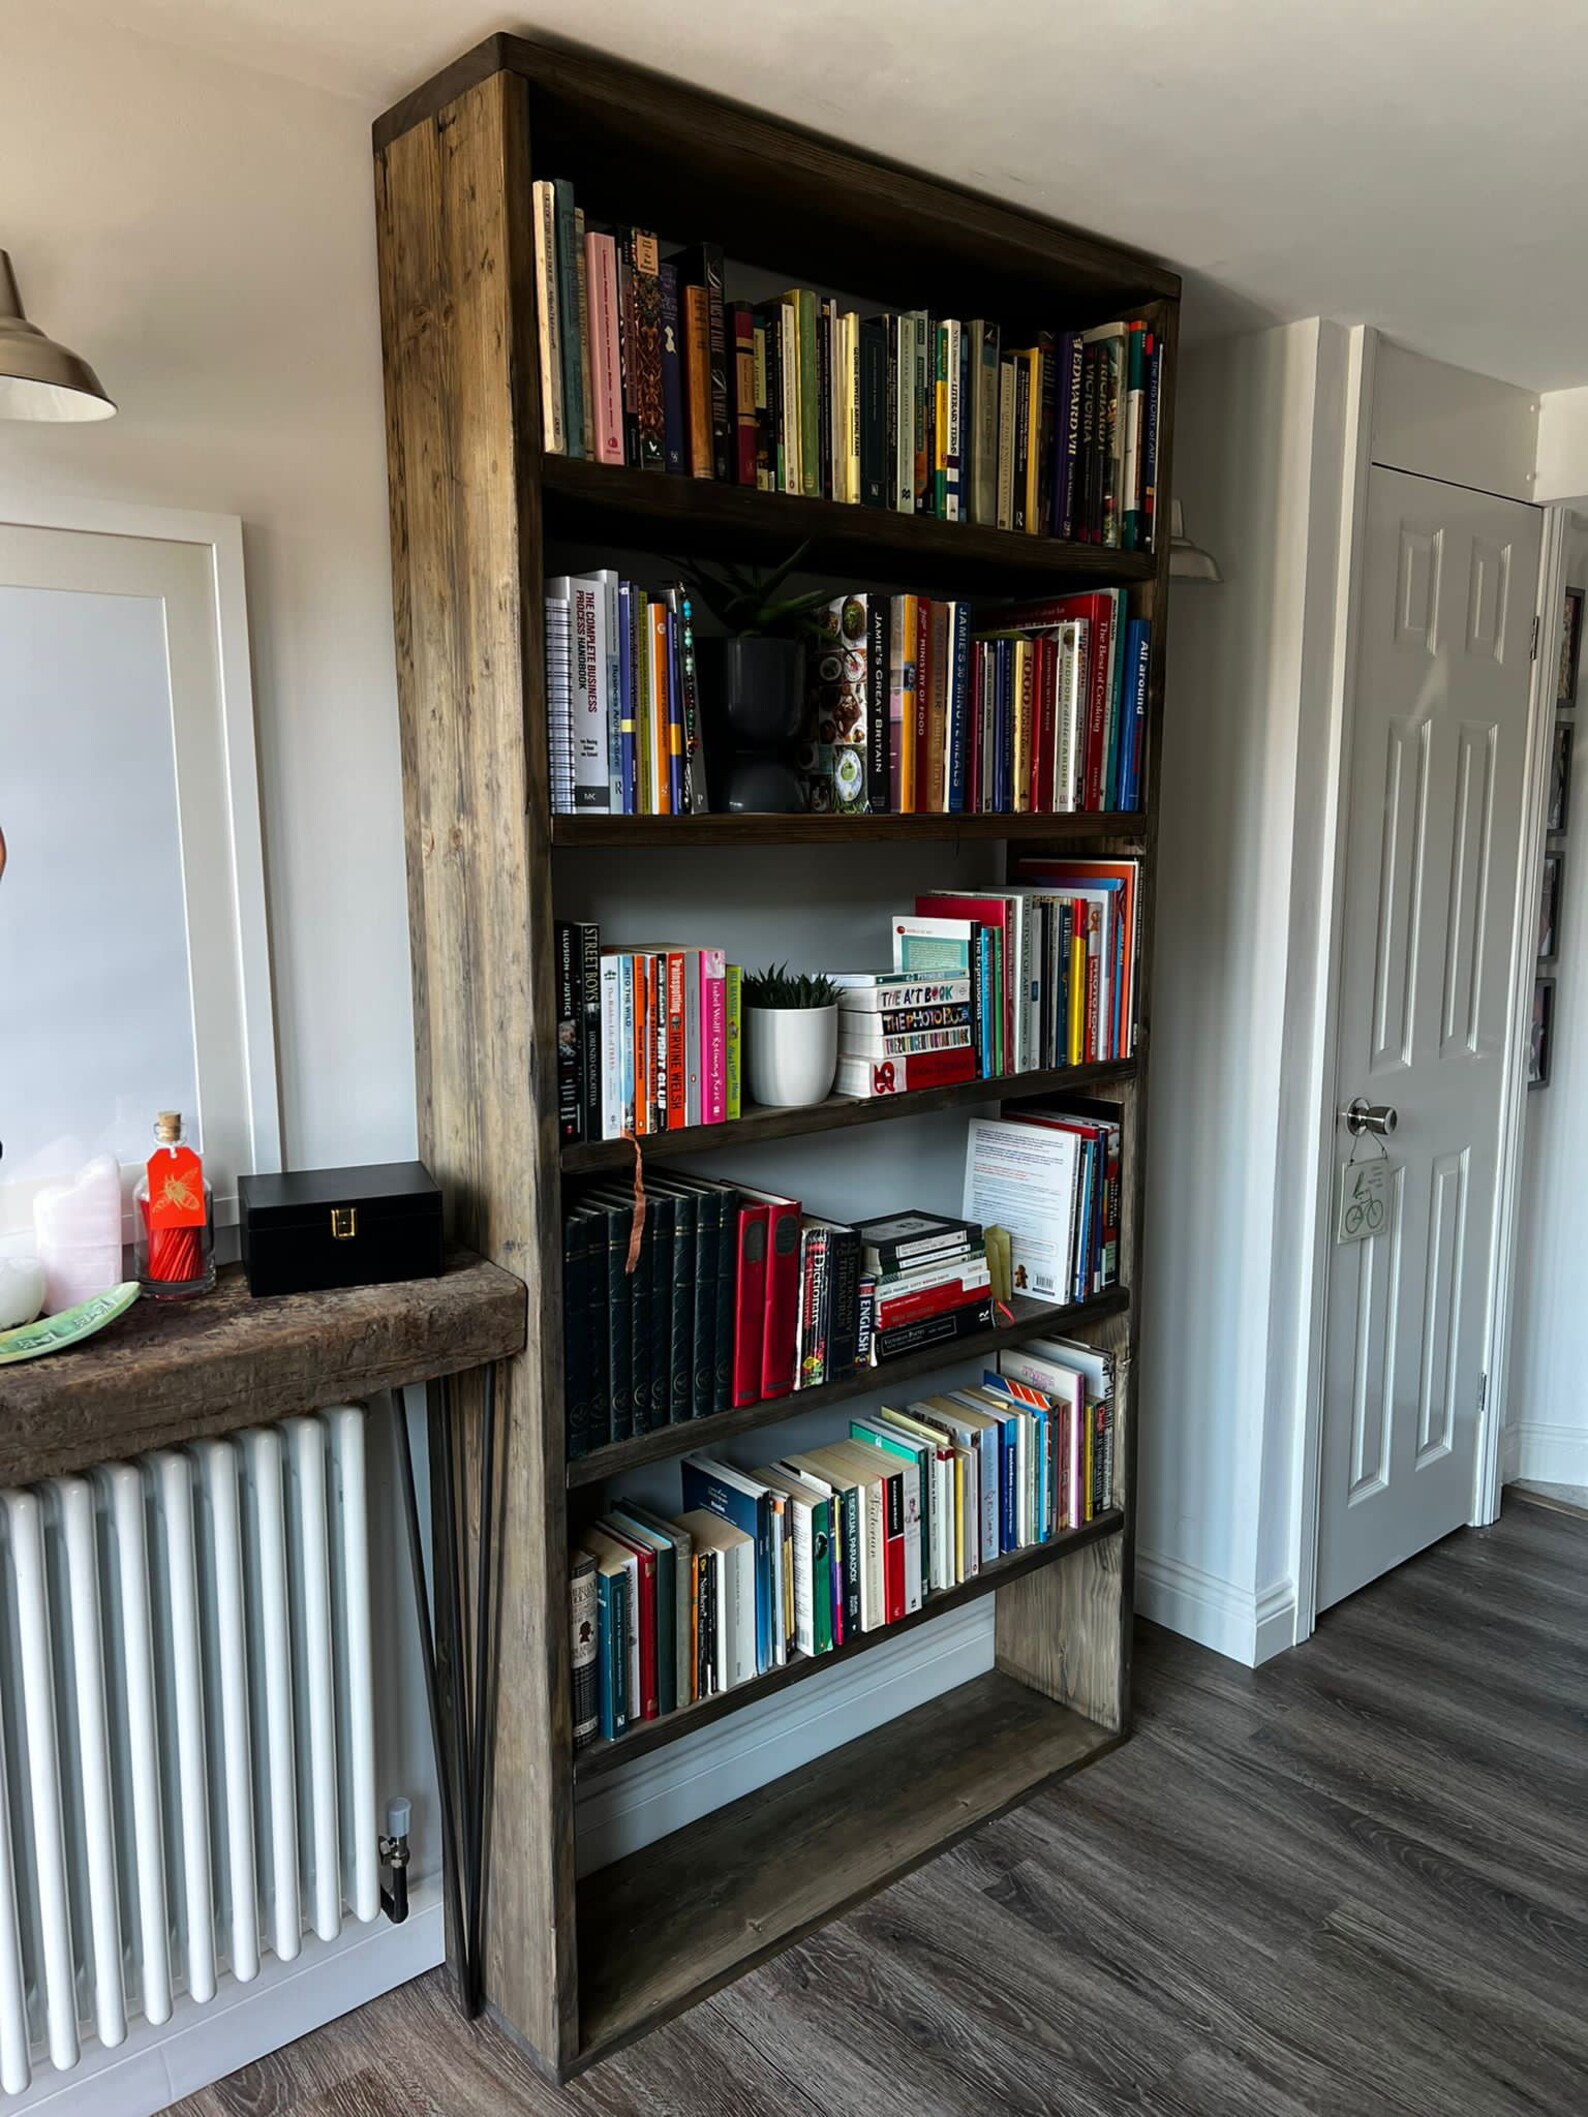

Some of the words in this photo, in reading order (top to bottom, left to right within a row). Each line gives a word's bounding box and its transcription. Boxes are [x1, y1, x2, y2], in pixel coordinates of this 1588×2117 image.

[853, 347, 861, 375] GEORGE
[951, 384, 959, 423] LITERARY
[1068, 351, 1083, 431] EDWARD
[1082, 362, 1095, 444] VICTORIA
[1098, 362, 1110, 443] RICHARD
[1149, 380, 1158, 428] HISTORY
[950, 426, 959, 455] TERMS
[1067, 432, 1079, 456] VII
[576, 590, 586, 636] PROCESS
[586, 591, 595, 610] THE
[586, 611, 597, 663] COMPLETE
[874, 611, 883, 665] JAMIE'S
[957, 606, 968, 663] JAMIE'S
[1099, 620, 1109, 644] The
[1139, 640, 1150, 662] All
[578, 637, 588, 691] HANDBOOK
[919, 638, 927, 687] MINISTRY
[1096, 671, 1104, 683] of
[1098, 644, 1108, 670] Best
[588, 664, 598, 713] BUSINESS
[611, 664, 620, 708] Business
[875, 669, 884, 715] GREAT
[918, 688, 926, 704] OF
[1022, 655, 1033, 706] 1000
[1064, 655, 1073, 702] INDOOR
[1136, 663, 1148, 716] around
[918, 705, 926, 737] FOOD
[1062, 703, 1070, 739] edible
[1092, 684, 1105, 735] Cooking
[612, 709, 622, 768] Architecture
[875, 718, 883, 774] BRITAIN
[952, 740, 963, 788] MEALS
[1061, 739, 1069, 789] GARDEN
[1024, 898, 1033, 917] THE
[562, 929, 571, 971] ILLUSION
[584, 927, 599, 970] STREET
[975, 937, 984, 955] The
[1023, 920, 1032, 958] STORY
[585, 971, 599, 1003] BOYS
[625, 966, 633, 987] INTO
[669, 958, 684, 1014] Trainspotting
[1023, 959, 1031, 973] OF
[563, 981, 572, 1018] JUSTICE
[625, 988, 633, 1005] THE
[712, 981, 721, 1008] Isabel
[881, 989, 902, 1007] THE
[903, 988, 924, 1005] ART
[924, 985, 954, 1003] BOOK
[975, 956, 984, 1020] Expressionists
[1023, 977, 1031, 998] ART
[625, 1006, 633, 1029] WILD
[712, 1008, 721, 1034] Wolff
[883, 1012, 906, 1033] THE
[906, 1010, 943, 1030] PHOTO
[1090, 1010, 1098, 1056] ICONS
[588, 1030, 598, 1063] LORENZO
[657, 1026, 667, 1070] FIGHT
[670, 1032, 682, 1068] IRVINE
[589, 1063, 598, 1108] CARCATERRA
[657, 1072, 667, 1110] CLUB
[671, 1071, 683, 1110] WELSH
[810, 1253, 826, 1327] Dictionary
[836, 1257, 849, 1328] THESAURUS
[845, 1256, 857, 1332] DICTIONARY
[858, 1299, 873, 1353] ENGLISH
[848, 1499, 858, 1538] SEXUAL
[848, 1538, 858, 1585] PARADOX
